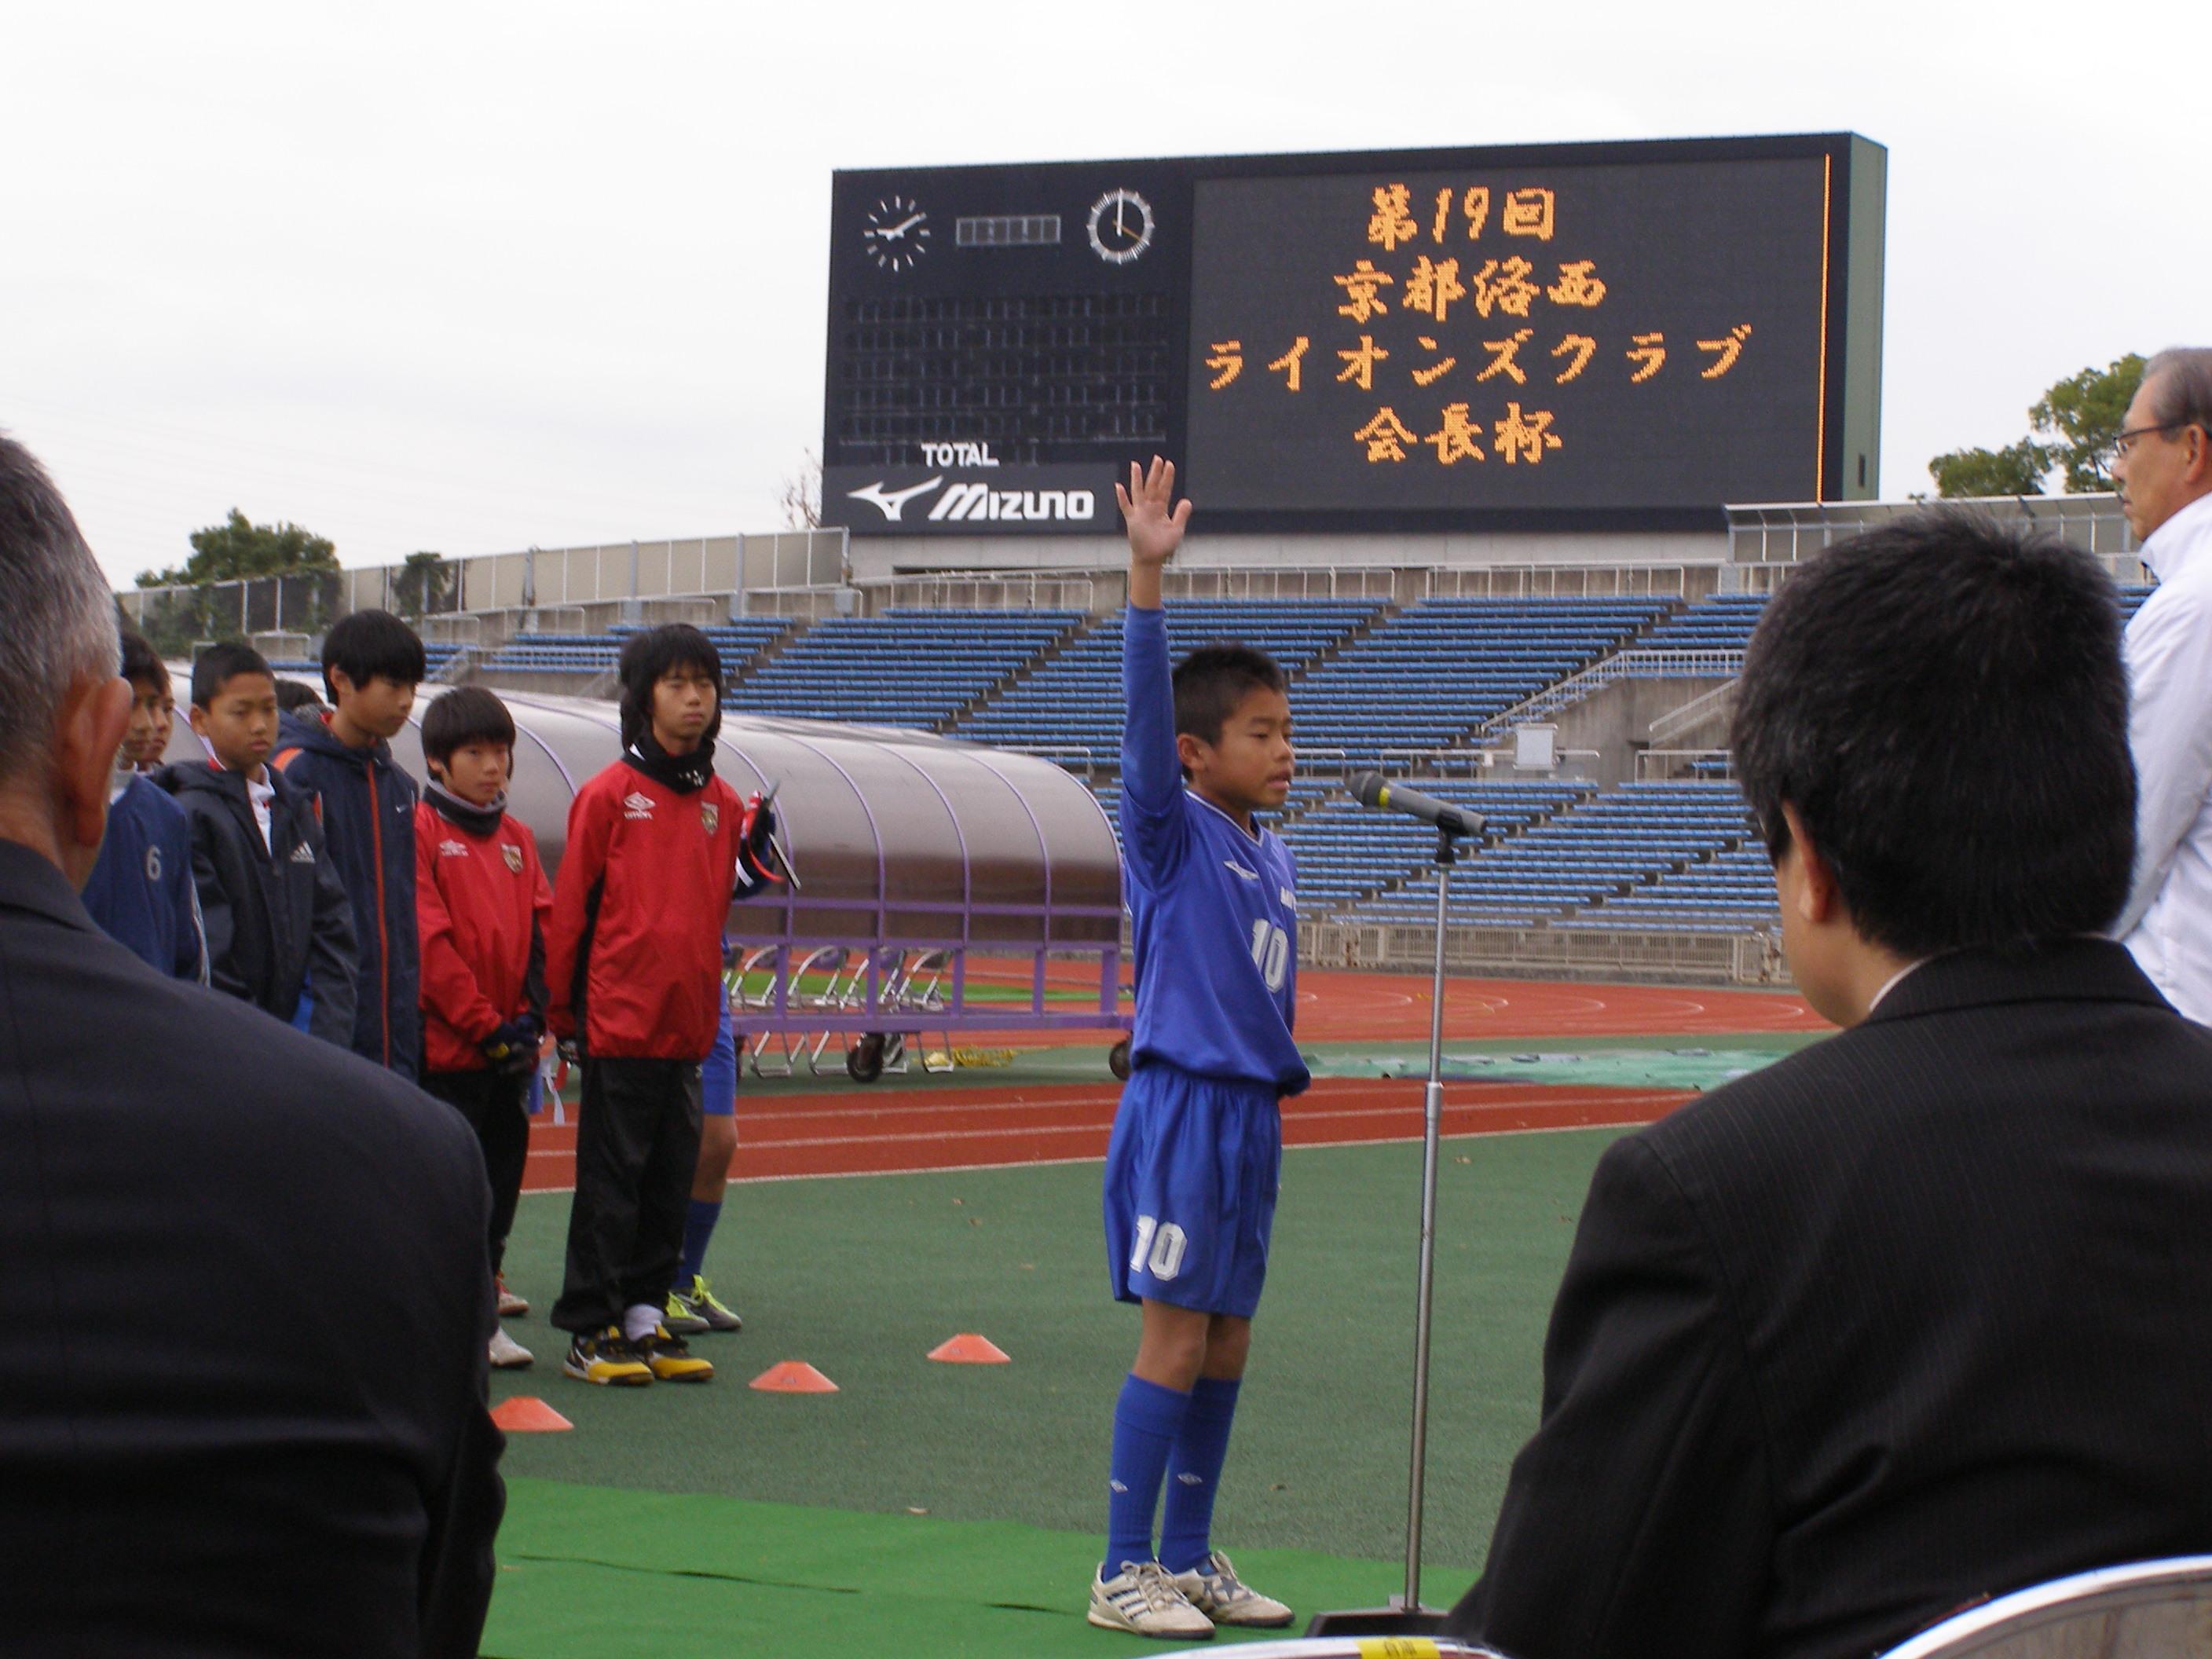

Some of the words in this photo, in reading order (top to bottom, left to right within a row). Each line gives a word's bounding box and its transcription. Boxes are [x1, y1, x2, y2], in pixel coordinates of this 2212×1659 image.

[1368, 182, 1555, 251] 第19回
[1333, 255, 1607, 324] 京都洛西
[1205, 323, 1752, 391] ライオンズクラブ
[921, 441, 1000, 467] TOTAL
[1353, 401, 1563, 465] 会長杯
[146, 845, 162, 881] 6
[1251, 917, 1289, 994] 10
[1130, 1214, 1188, 1282] 10
